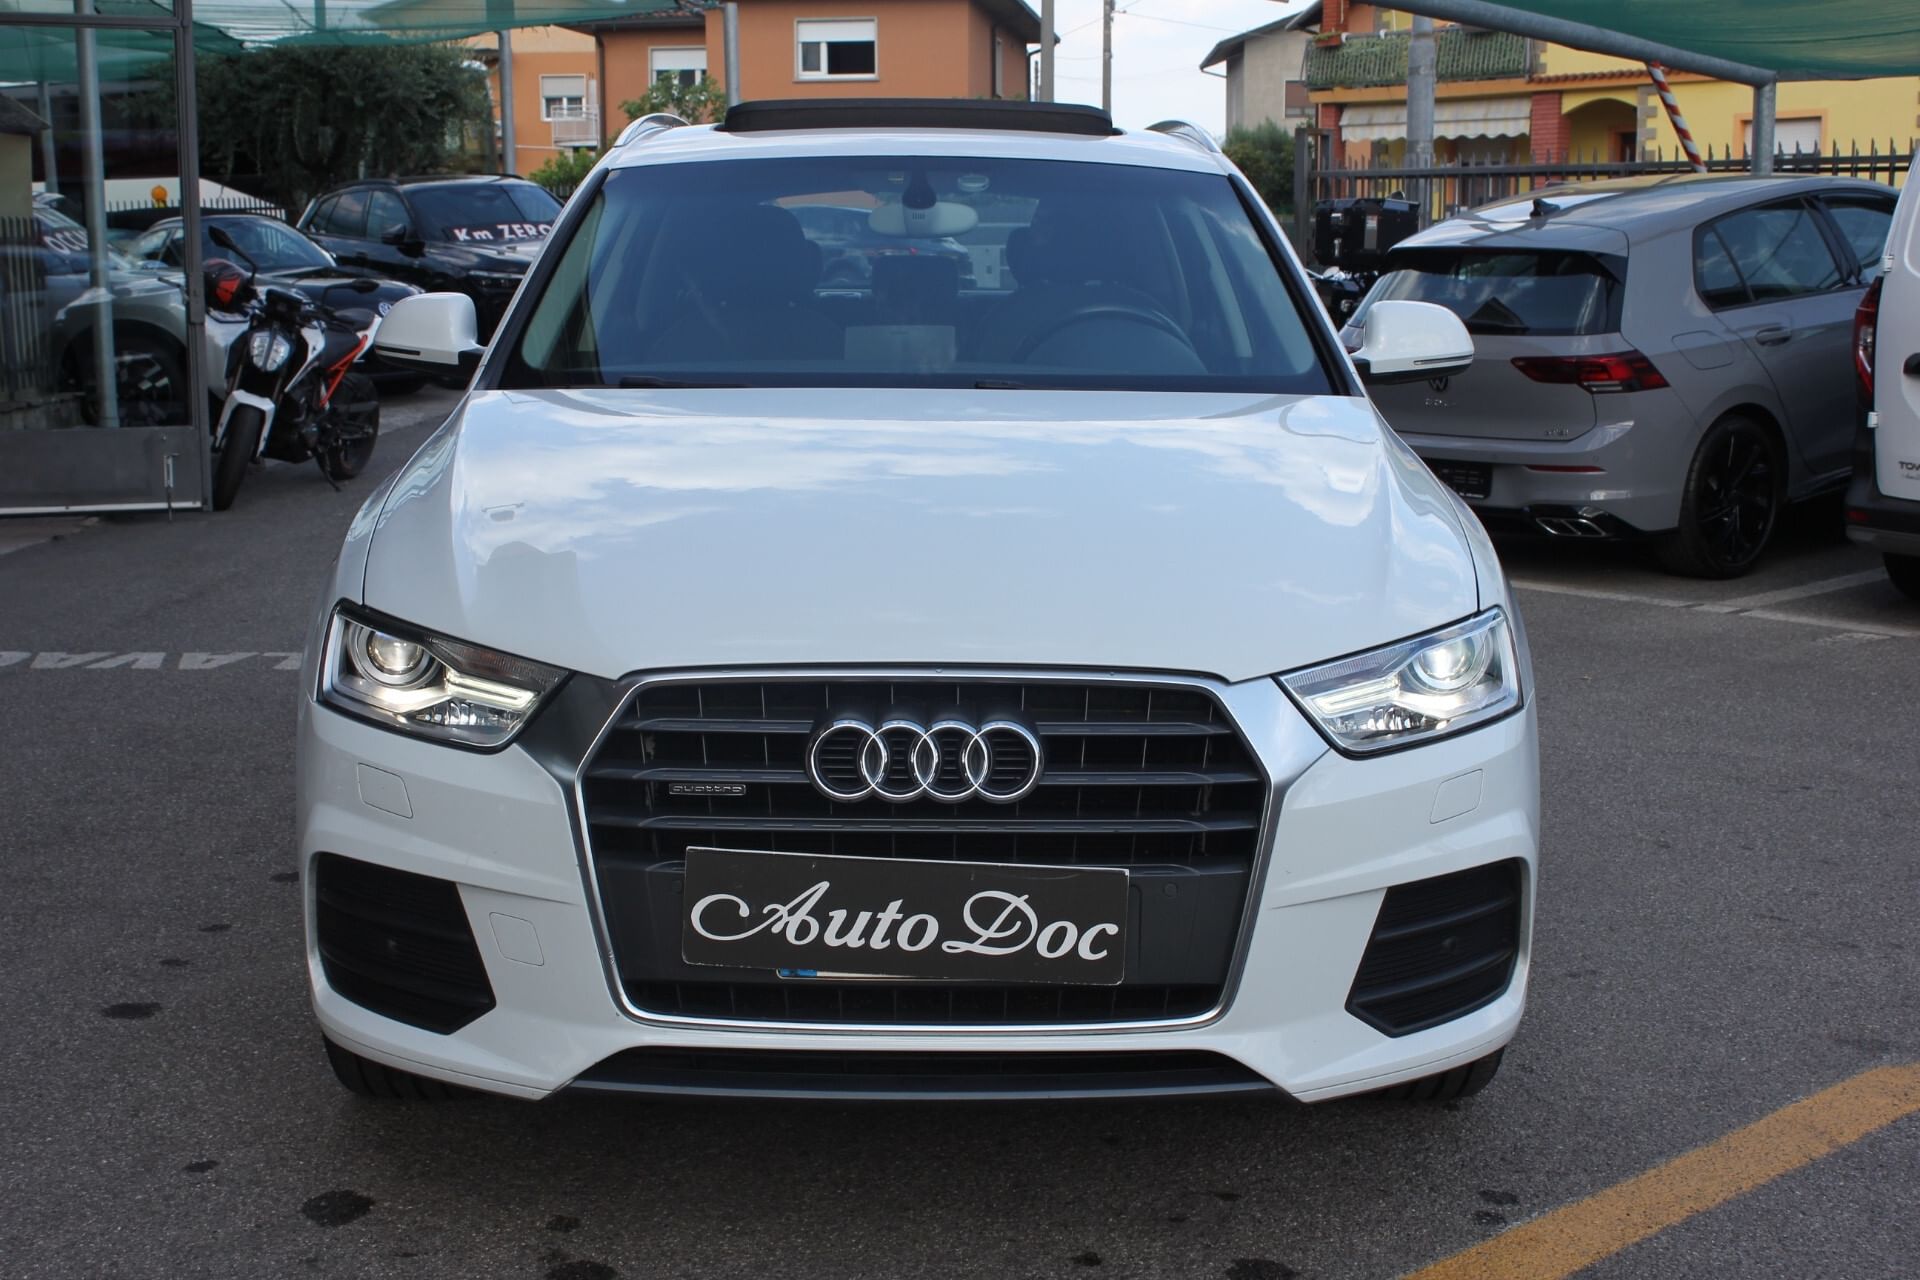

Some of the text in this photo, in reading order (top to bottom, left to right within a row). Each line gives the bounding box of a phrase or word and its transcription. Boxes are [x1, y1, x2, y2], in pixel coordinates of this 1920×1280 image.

[453, 228, 494, 241] Km
[690, 880, 1119, 961] Auto Doc
